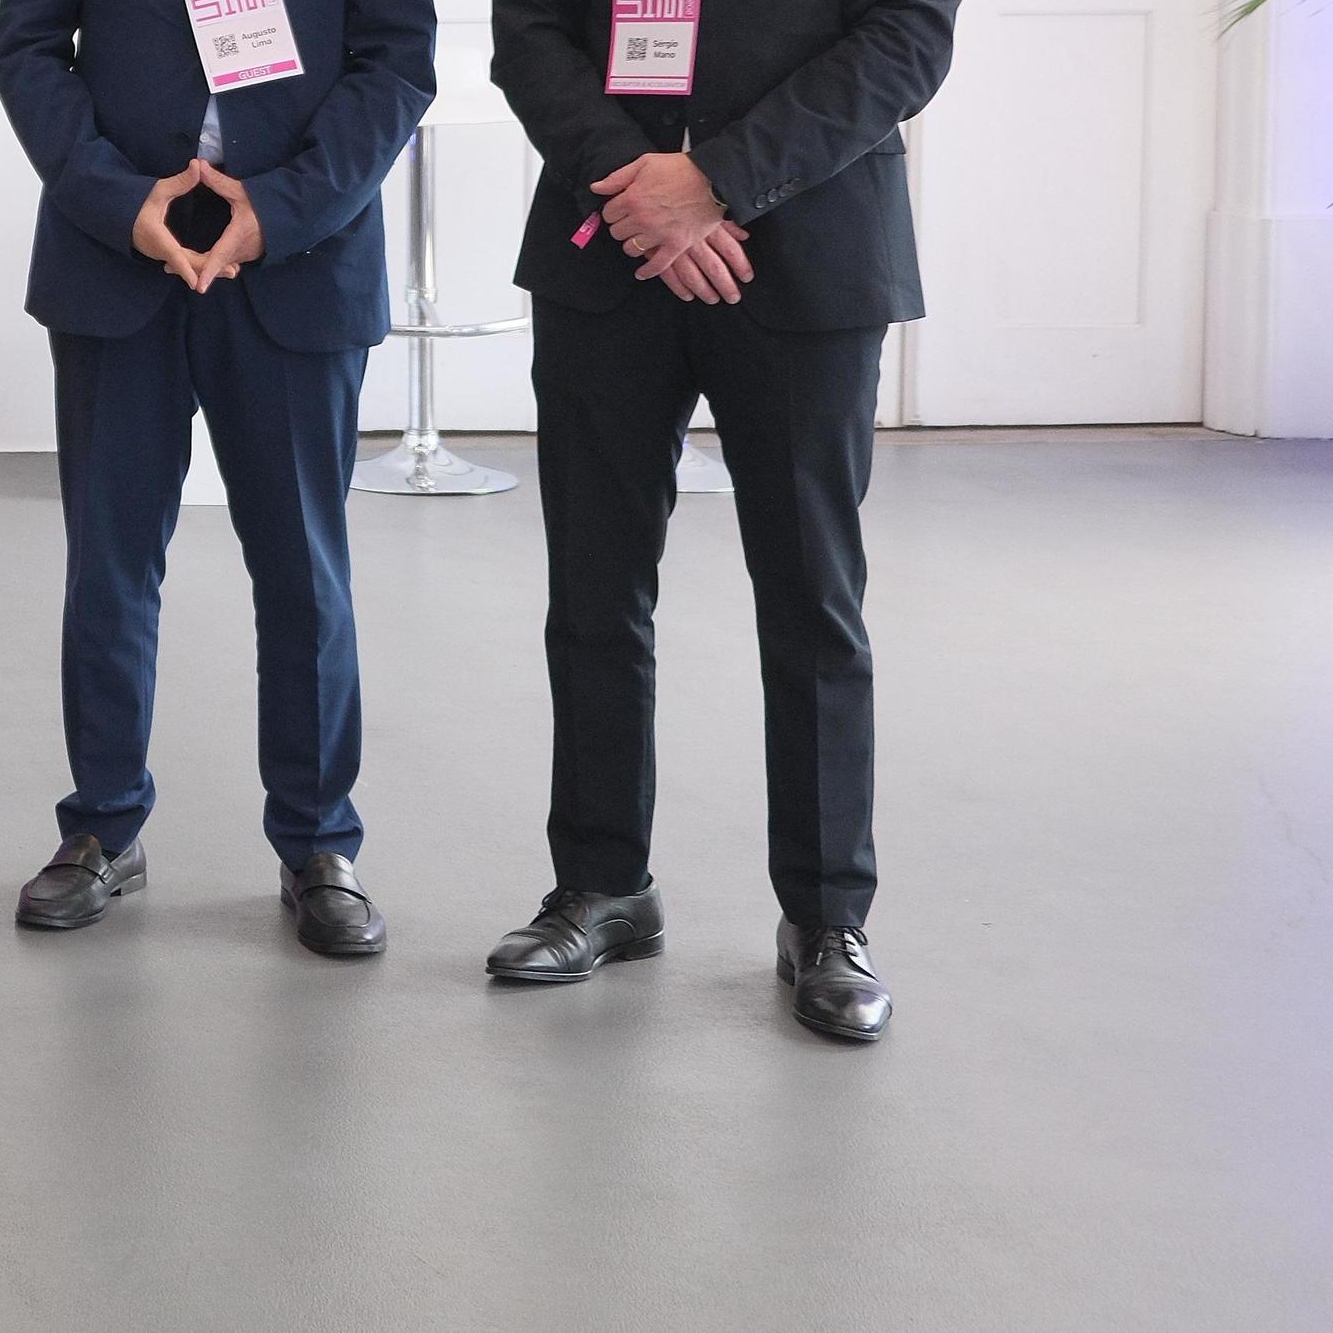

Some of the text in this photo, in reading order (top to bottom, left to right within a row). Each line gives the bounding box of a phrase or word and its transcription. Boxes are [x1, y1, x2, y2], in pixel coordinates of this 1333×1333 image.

[241, 27, 277, 40] Augusto
[252, 39, 273, 48] Lima
[238, 66, 271, 80] GUEST
